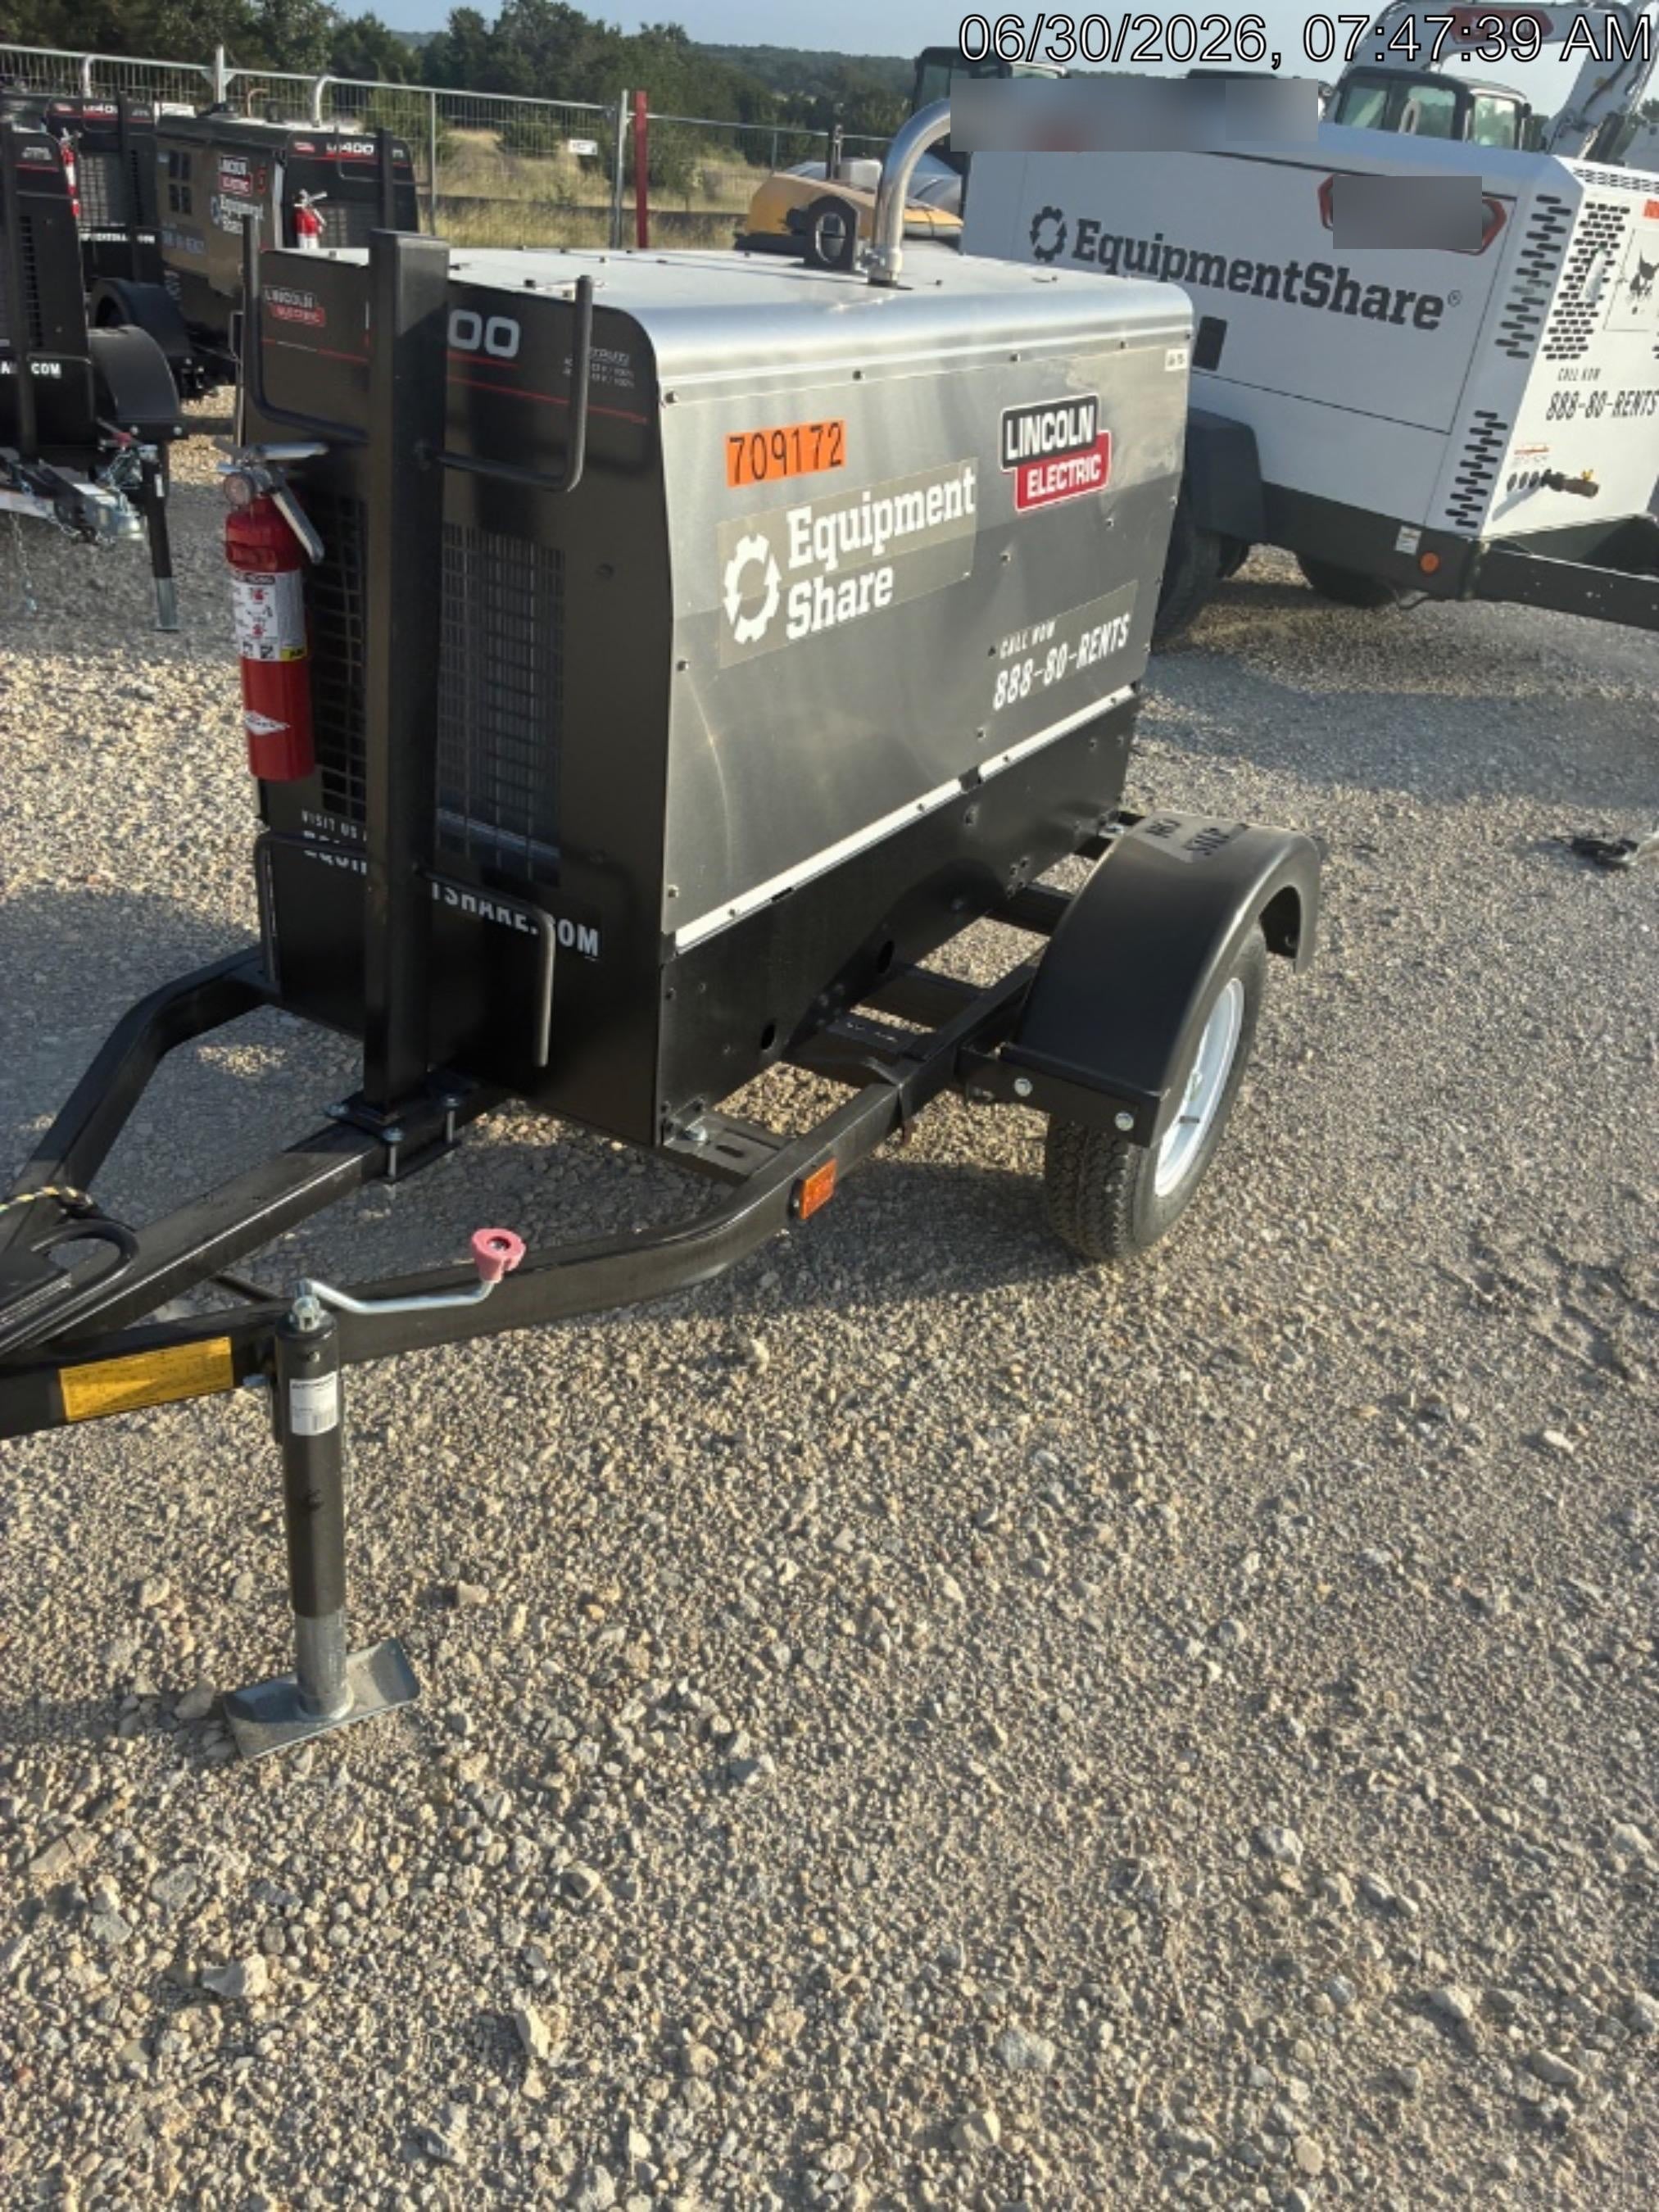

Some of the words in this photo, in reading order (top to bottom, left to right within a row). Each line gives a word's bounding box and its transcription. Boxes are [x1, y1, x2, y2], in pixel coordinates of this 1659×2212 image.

[730, 422, 842, 484] 709172
[1006, 404, 1095, 460] LINCOLN
[1027, 453, 1102, 499] ELECTRIC
[786, 466, 976, 571] Equipment
[786, 566, 894, 640] Share
[992, 614, 1131, 711] 888-80-RENTS
[301, 809, 335, 832] VISIT
[340, 823, 357, 839] US
